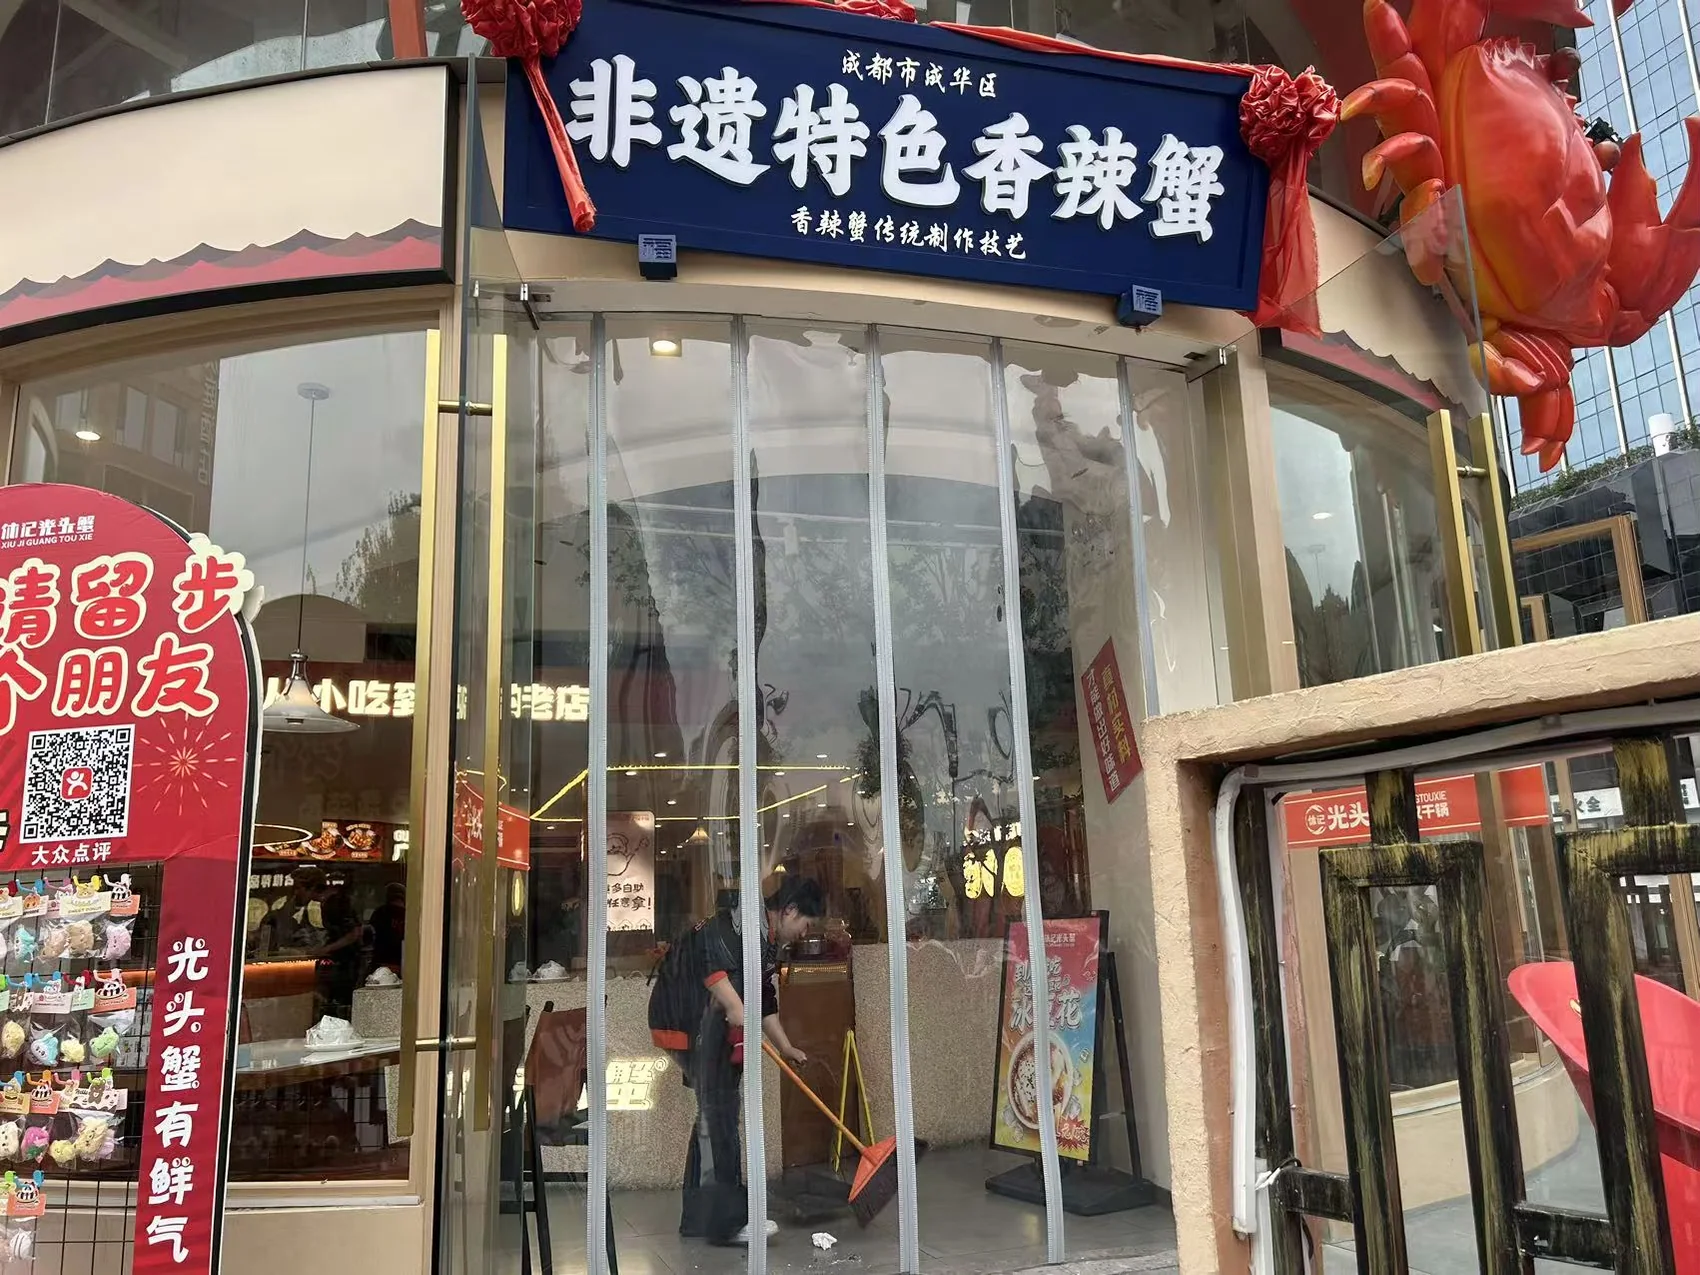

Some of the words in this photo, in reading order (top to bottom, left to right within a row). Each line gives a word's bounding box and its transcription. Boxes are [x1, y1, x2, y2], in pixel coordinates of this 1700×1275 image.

[842, 50, 998, 98] 成都市成华区
[565, 54, 1225, 245] 非遗特色香辣蟹
[790, 206, 1027, 260] 香辣蟹传统制作技艺
[1, 539, 16, 549] XIU
[17, 538, 25, 547] JI
[26, 536, 58, 547] GUANG
[59, 534, 78, 544] TOU
[79, 533, 93, 541] XIE
[31, 841, 112, 865] 大众点评
[146, 936, 209, 1264] 光头蟹有鲜气
